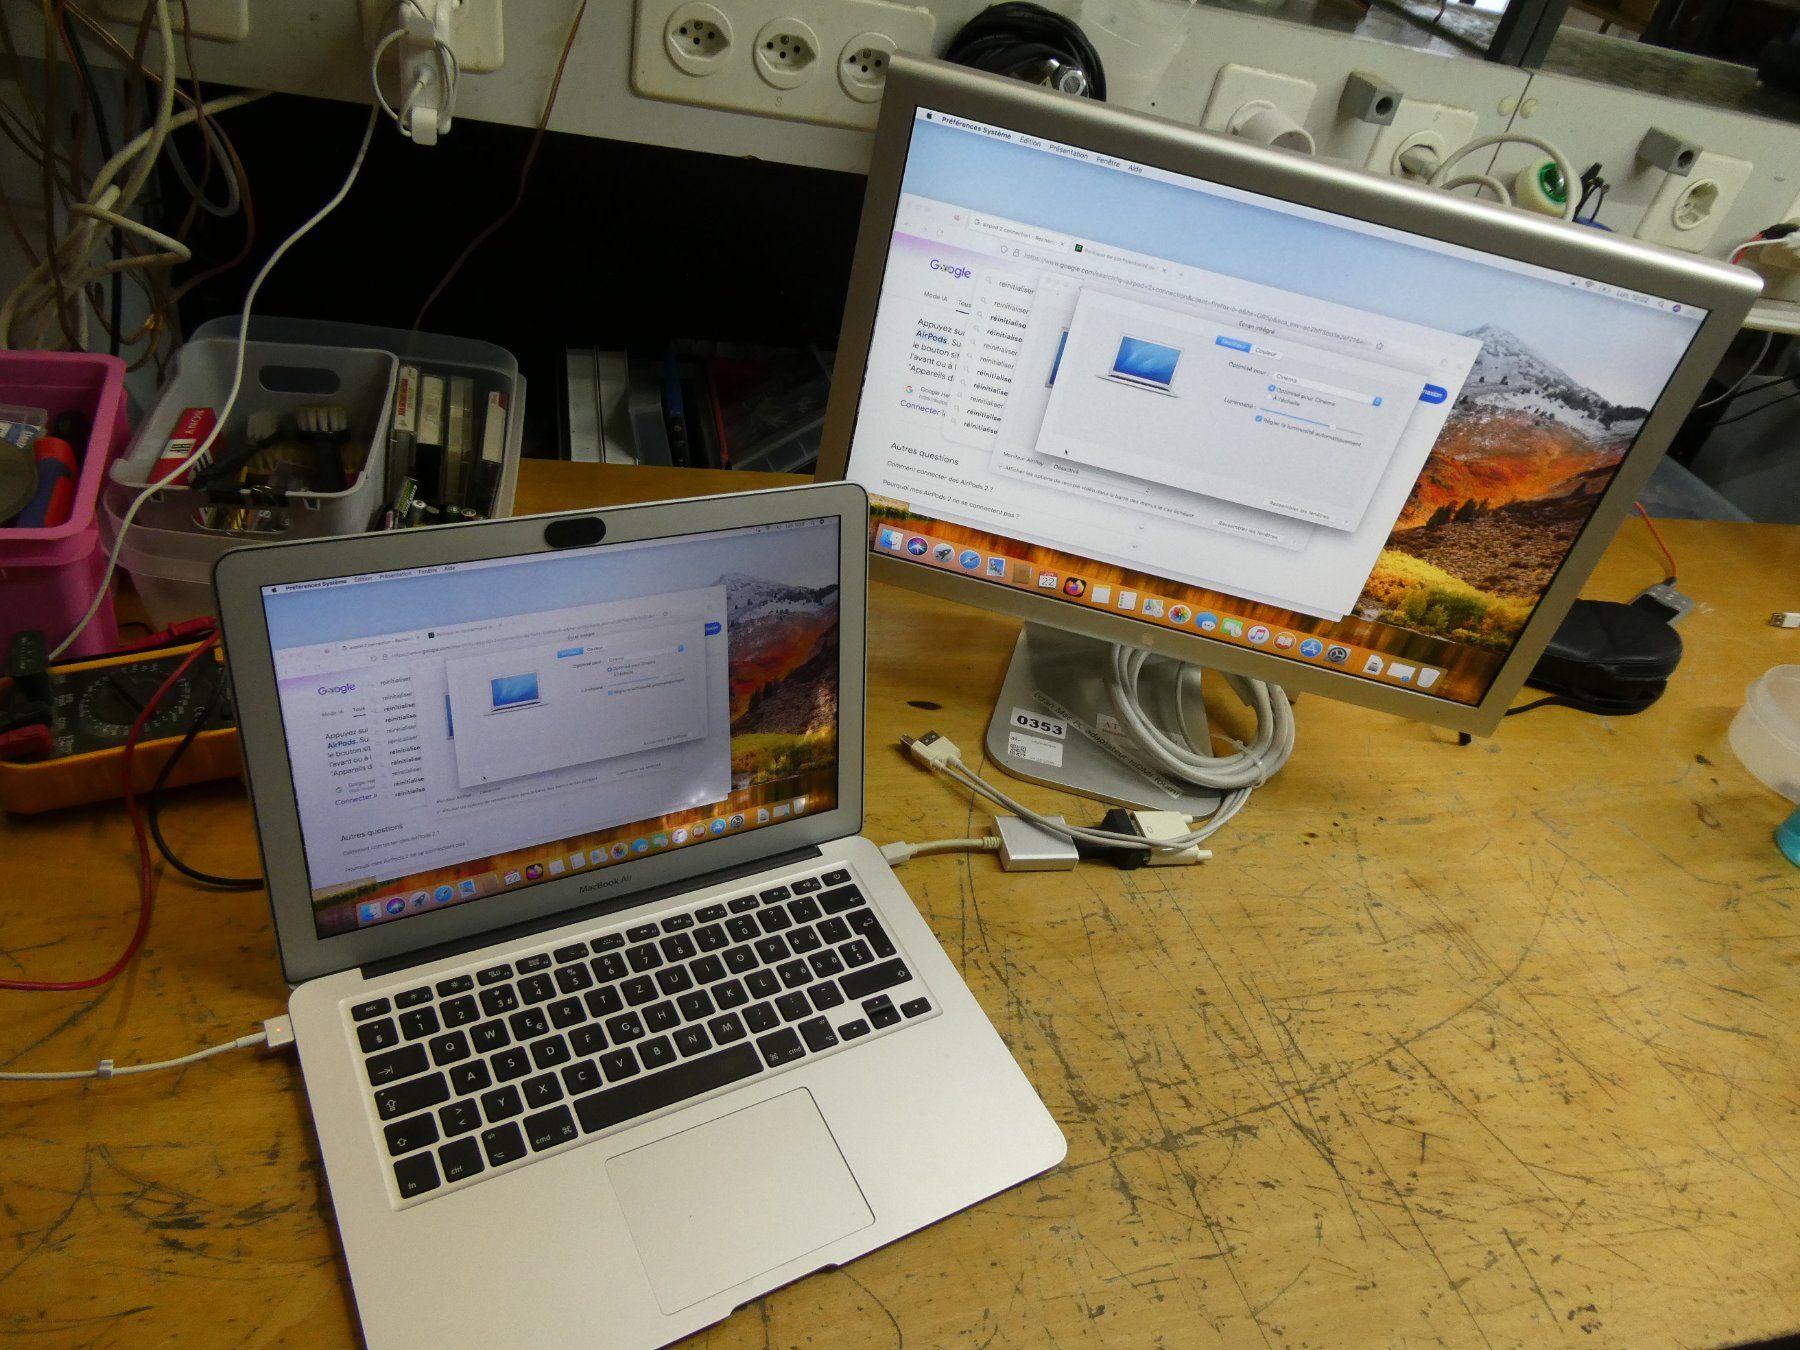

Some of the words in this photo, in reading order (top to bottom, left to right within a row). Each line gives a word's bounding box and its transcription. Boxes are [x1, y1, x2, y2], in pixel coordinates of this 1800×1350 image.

[928, 257, 972, 281] Google
[920, 343, 949, 356] bouton
[890, 441, 917, 455] Autres
[918, 448, 959, 467] questions
[1017, 715, 1063, 736] 0353
[579, 877, 619, 894] MacBook
